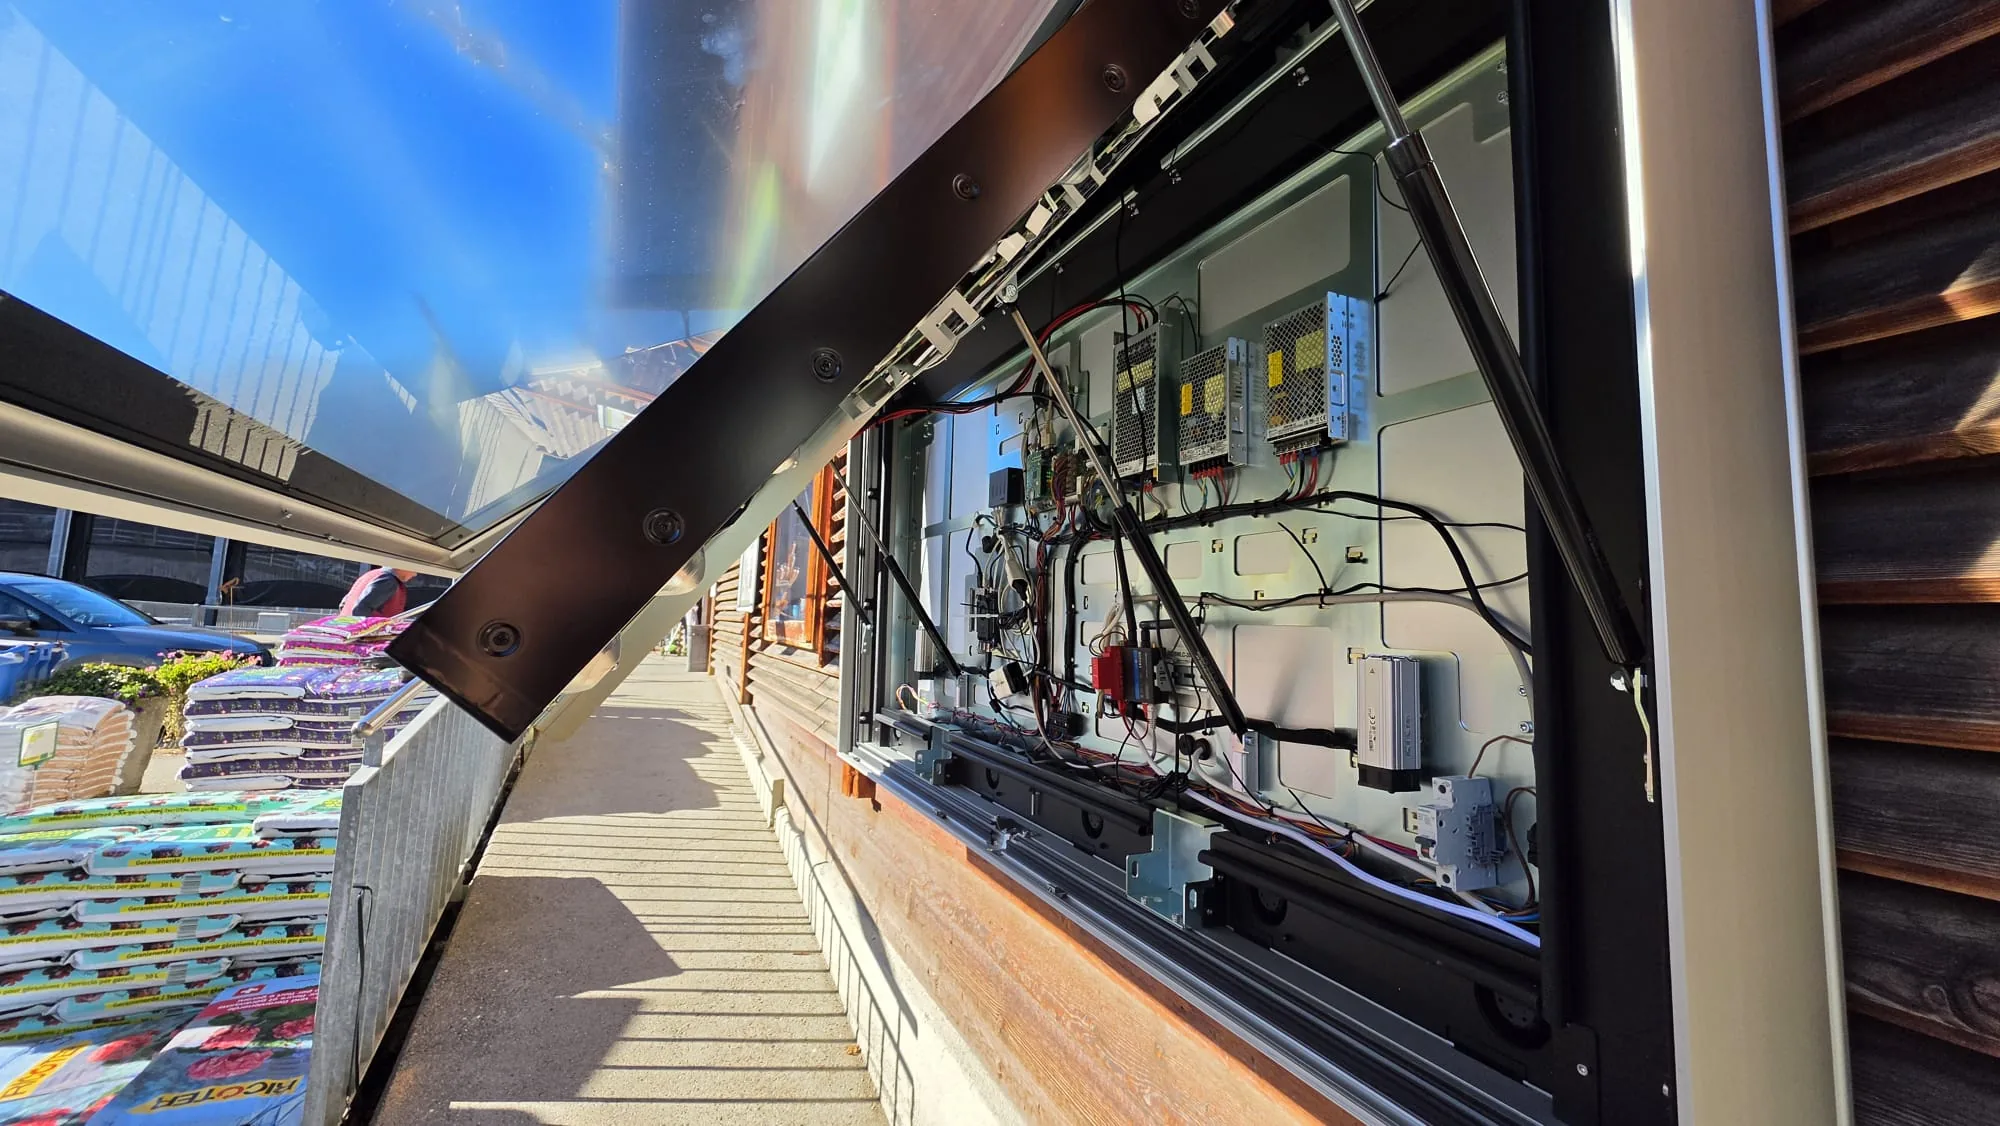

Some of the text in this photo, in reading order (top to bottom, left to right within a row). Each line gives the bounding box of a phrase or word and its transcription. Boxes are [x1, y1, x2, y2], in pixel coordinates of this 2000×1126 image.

[135, 857, 180, 866] Geranienerde
[187, 855, 212, 863] Terreau
[212, 854, 228, 862] pour
[229, 851, 262, 861] géraniums
[268, 849, 294, 857] Terriccio
[306, 848, 325, 857] gerani
[128, 904, 174, 912] Geranienerde
[262, 894, 288, 902] Terriccio
[300, 893, 319, 901] gerani
[126, 950, 172, 960] Geranienerde
[298, 937, 318, 945] gerani
[150, 1079, 298, 1111] RICOTER
